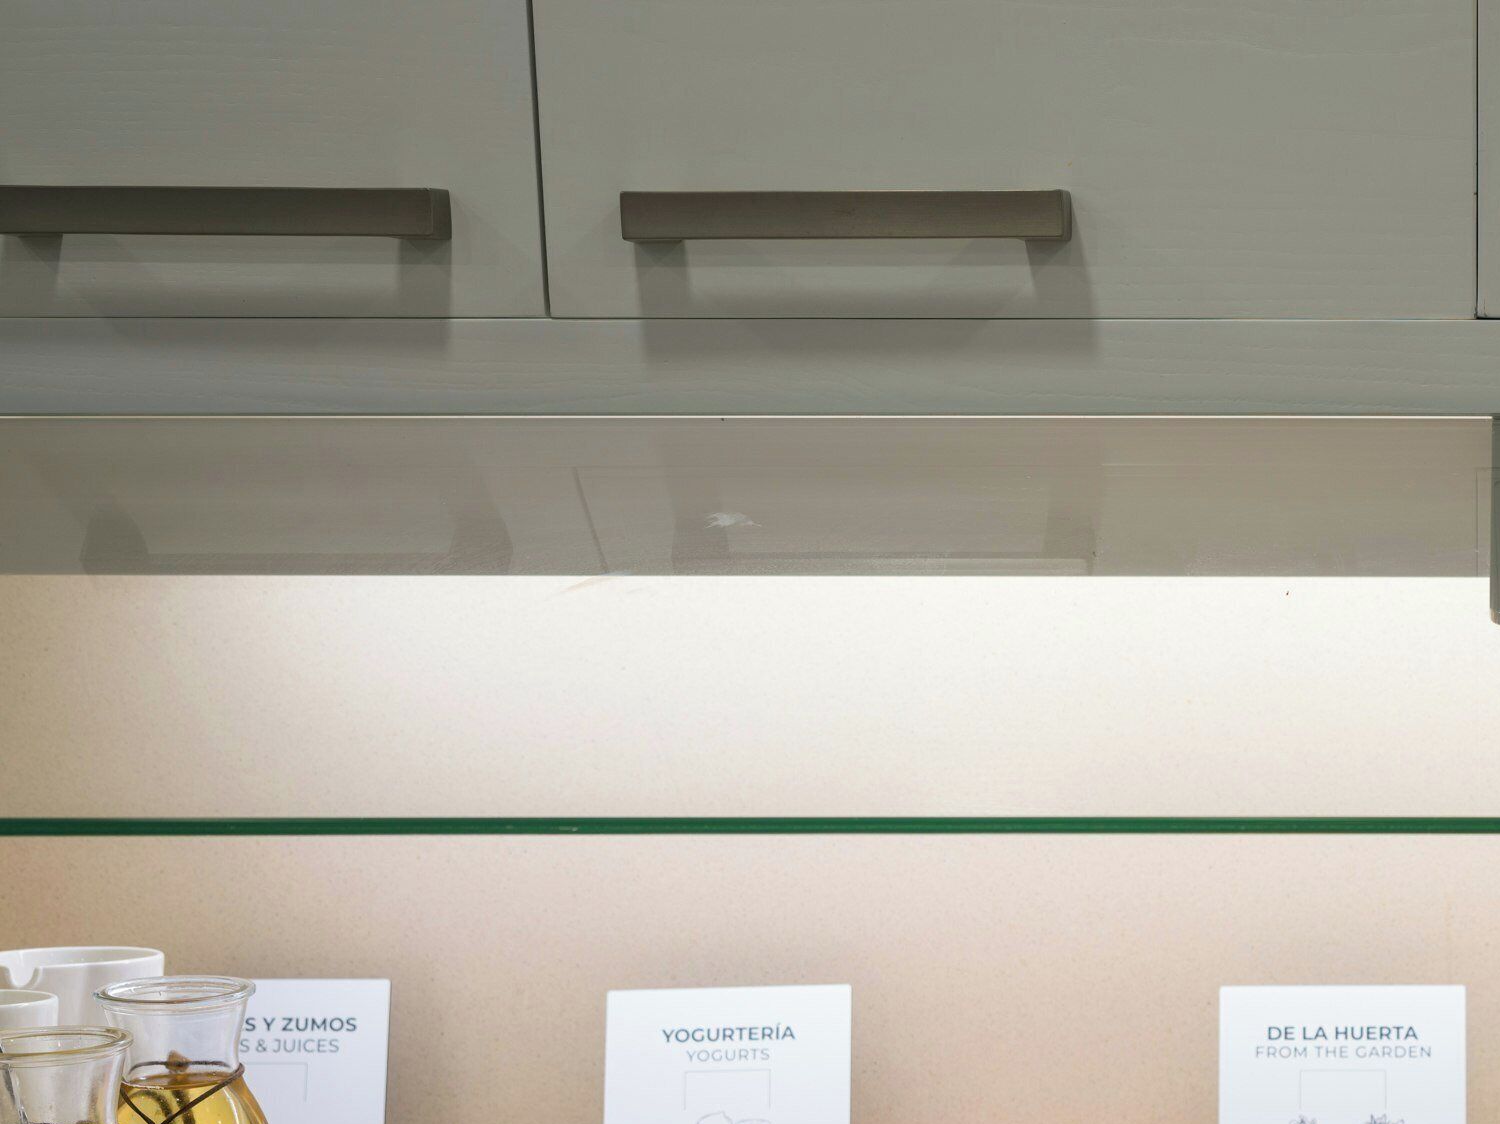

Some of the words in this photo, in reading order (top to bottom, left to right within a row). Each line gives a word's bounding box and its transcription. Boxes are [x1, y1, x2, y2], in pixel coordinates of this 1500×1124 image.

[264, 1017, 276, 1031] Y
[282, 1017, 357, 1032] ZUMOS
[662, 1022, 796, 1043] YOGURTERÍA
[1267, 1026, 1295, 1041] DE
[1303, 1026, 1328, 1041] LA
[1335, 1026, 1418, 1041] HUERTA
[255, 1039, 267, 1053] &
[273, 1039, 340, 1053] JUICES
[1255, 1045, 1308, 1059] FROM
[1314, 1045, 1349, 1059] THE
[1355, 1045, 1432, 1059] GARDEN
[686, 1048, 770, 1062] YOGURTS
